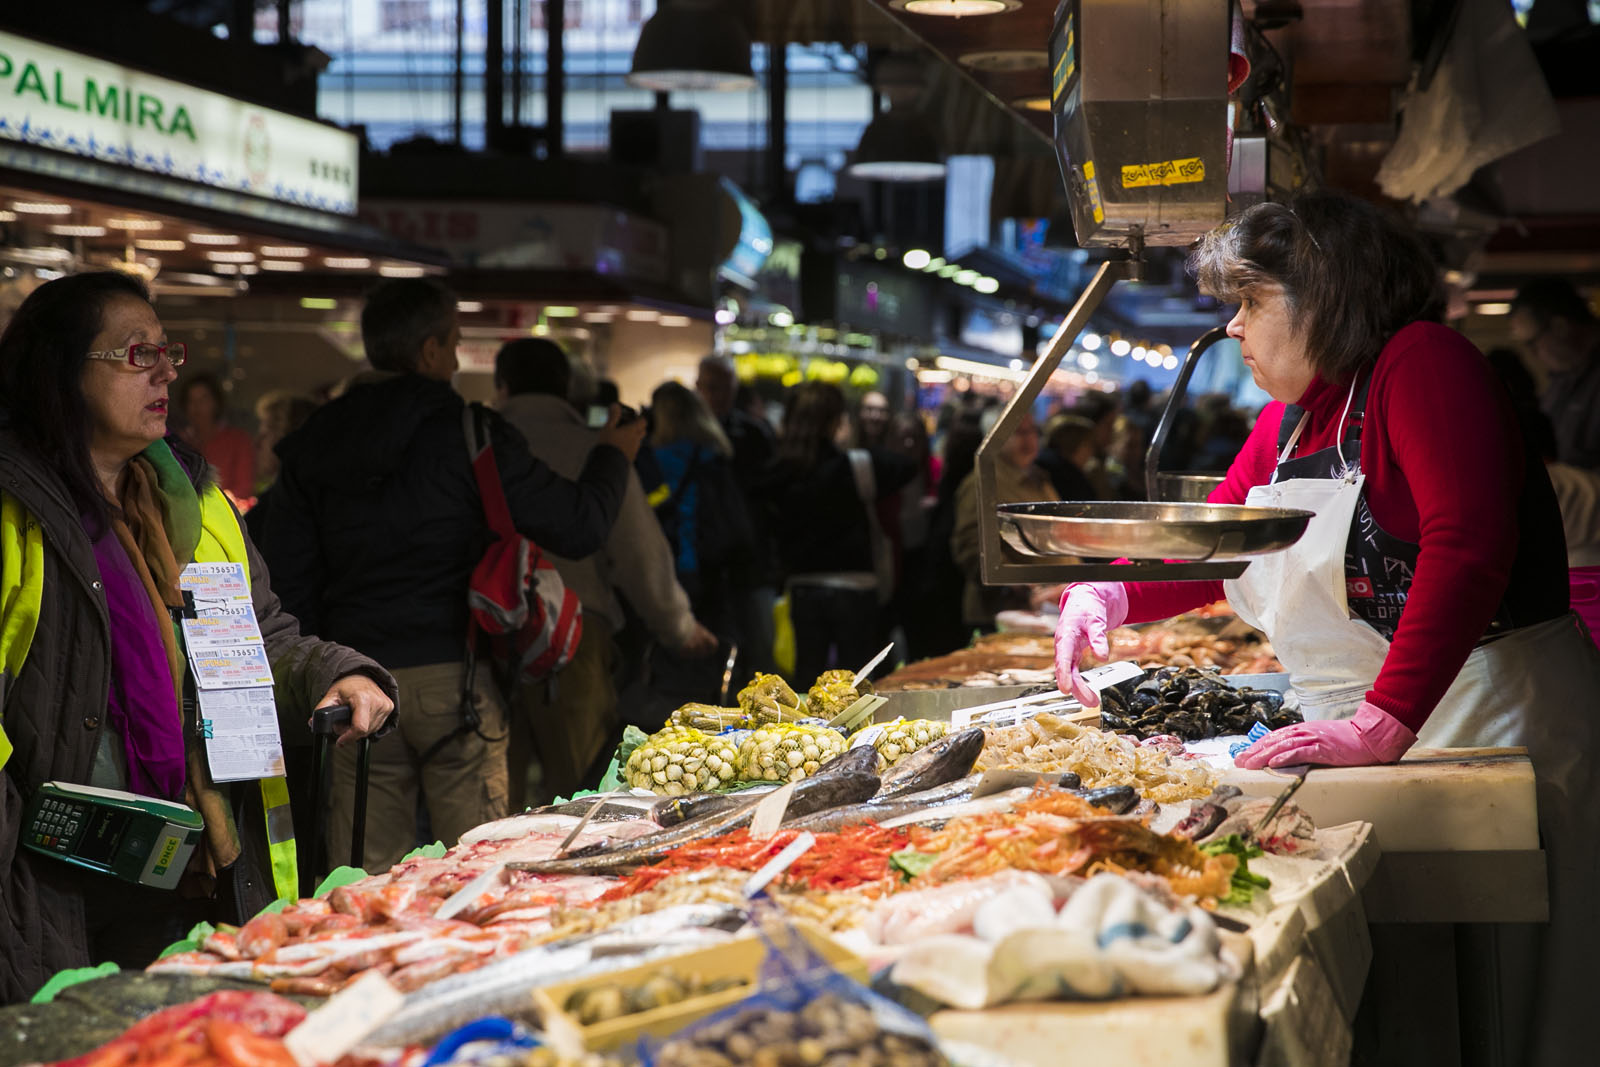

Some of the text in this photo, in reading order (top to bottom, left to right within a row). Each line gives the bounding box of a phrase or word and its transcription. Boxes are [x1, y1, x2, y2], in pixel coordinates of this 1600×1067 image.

[211, 566, 236, 574] 75657
[221, 607, 245, 616] 75657
[232, 649, 256, 657] 75657
[160, 839, 177, 866] ONCE
